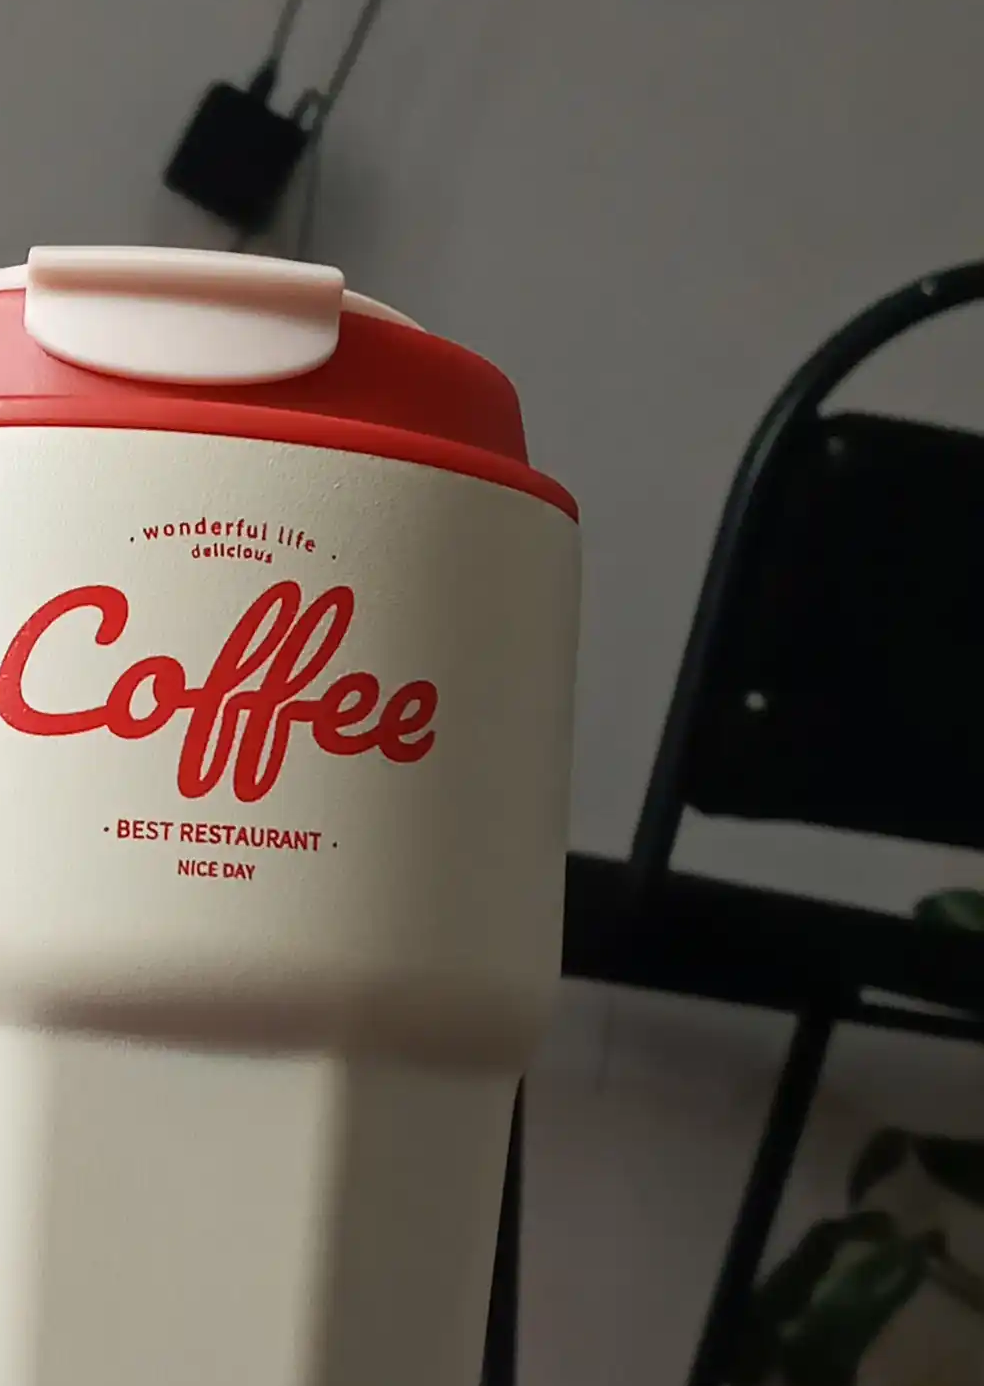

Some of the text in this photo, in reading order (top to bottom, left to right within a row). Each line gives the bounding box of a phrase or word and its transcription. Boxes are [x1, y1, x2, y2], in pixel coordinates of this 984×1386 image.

[142, 516, 318, 553] wonderful life
[190, 542, 274, 565] delicious
[116, 818, 322, 852] BEST RESTAURANT
[176, 859, 256, 880] NICE DAY
